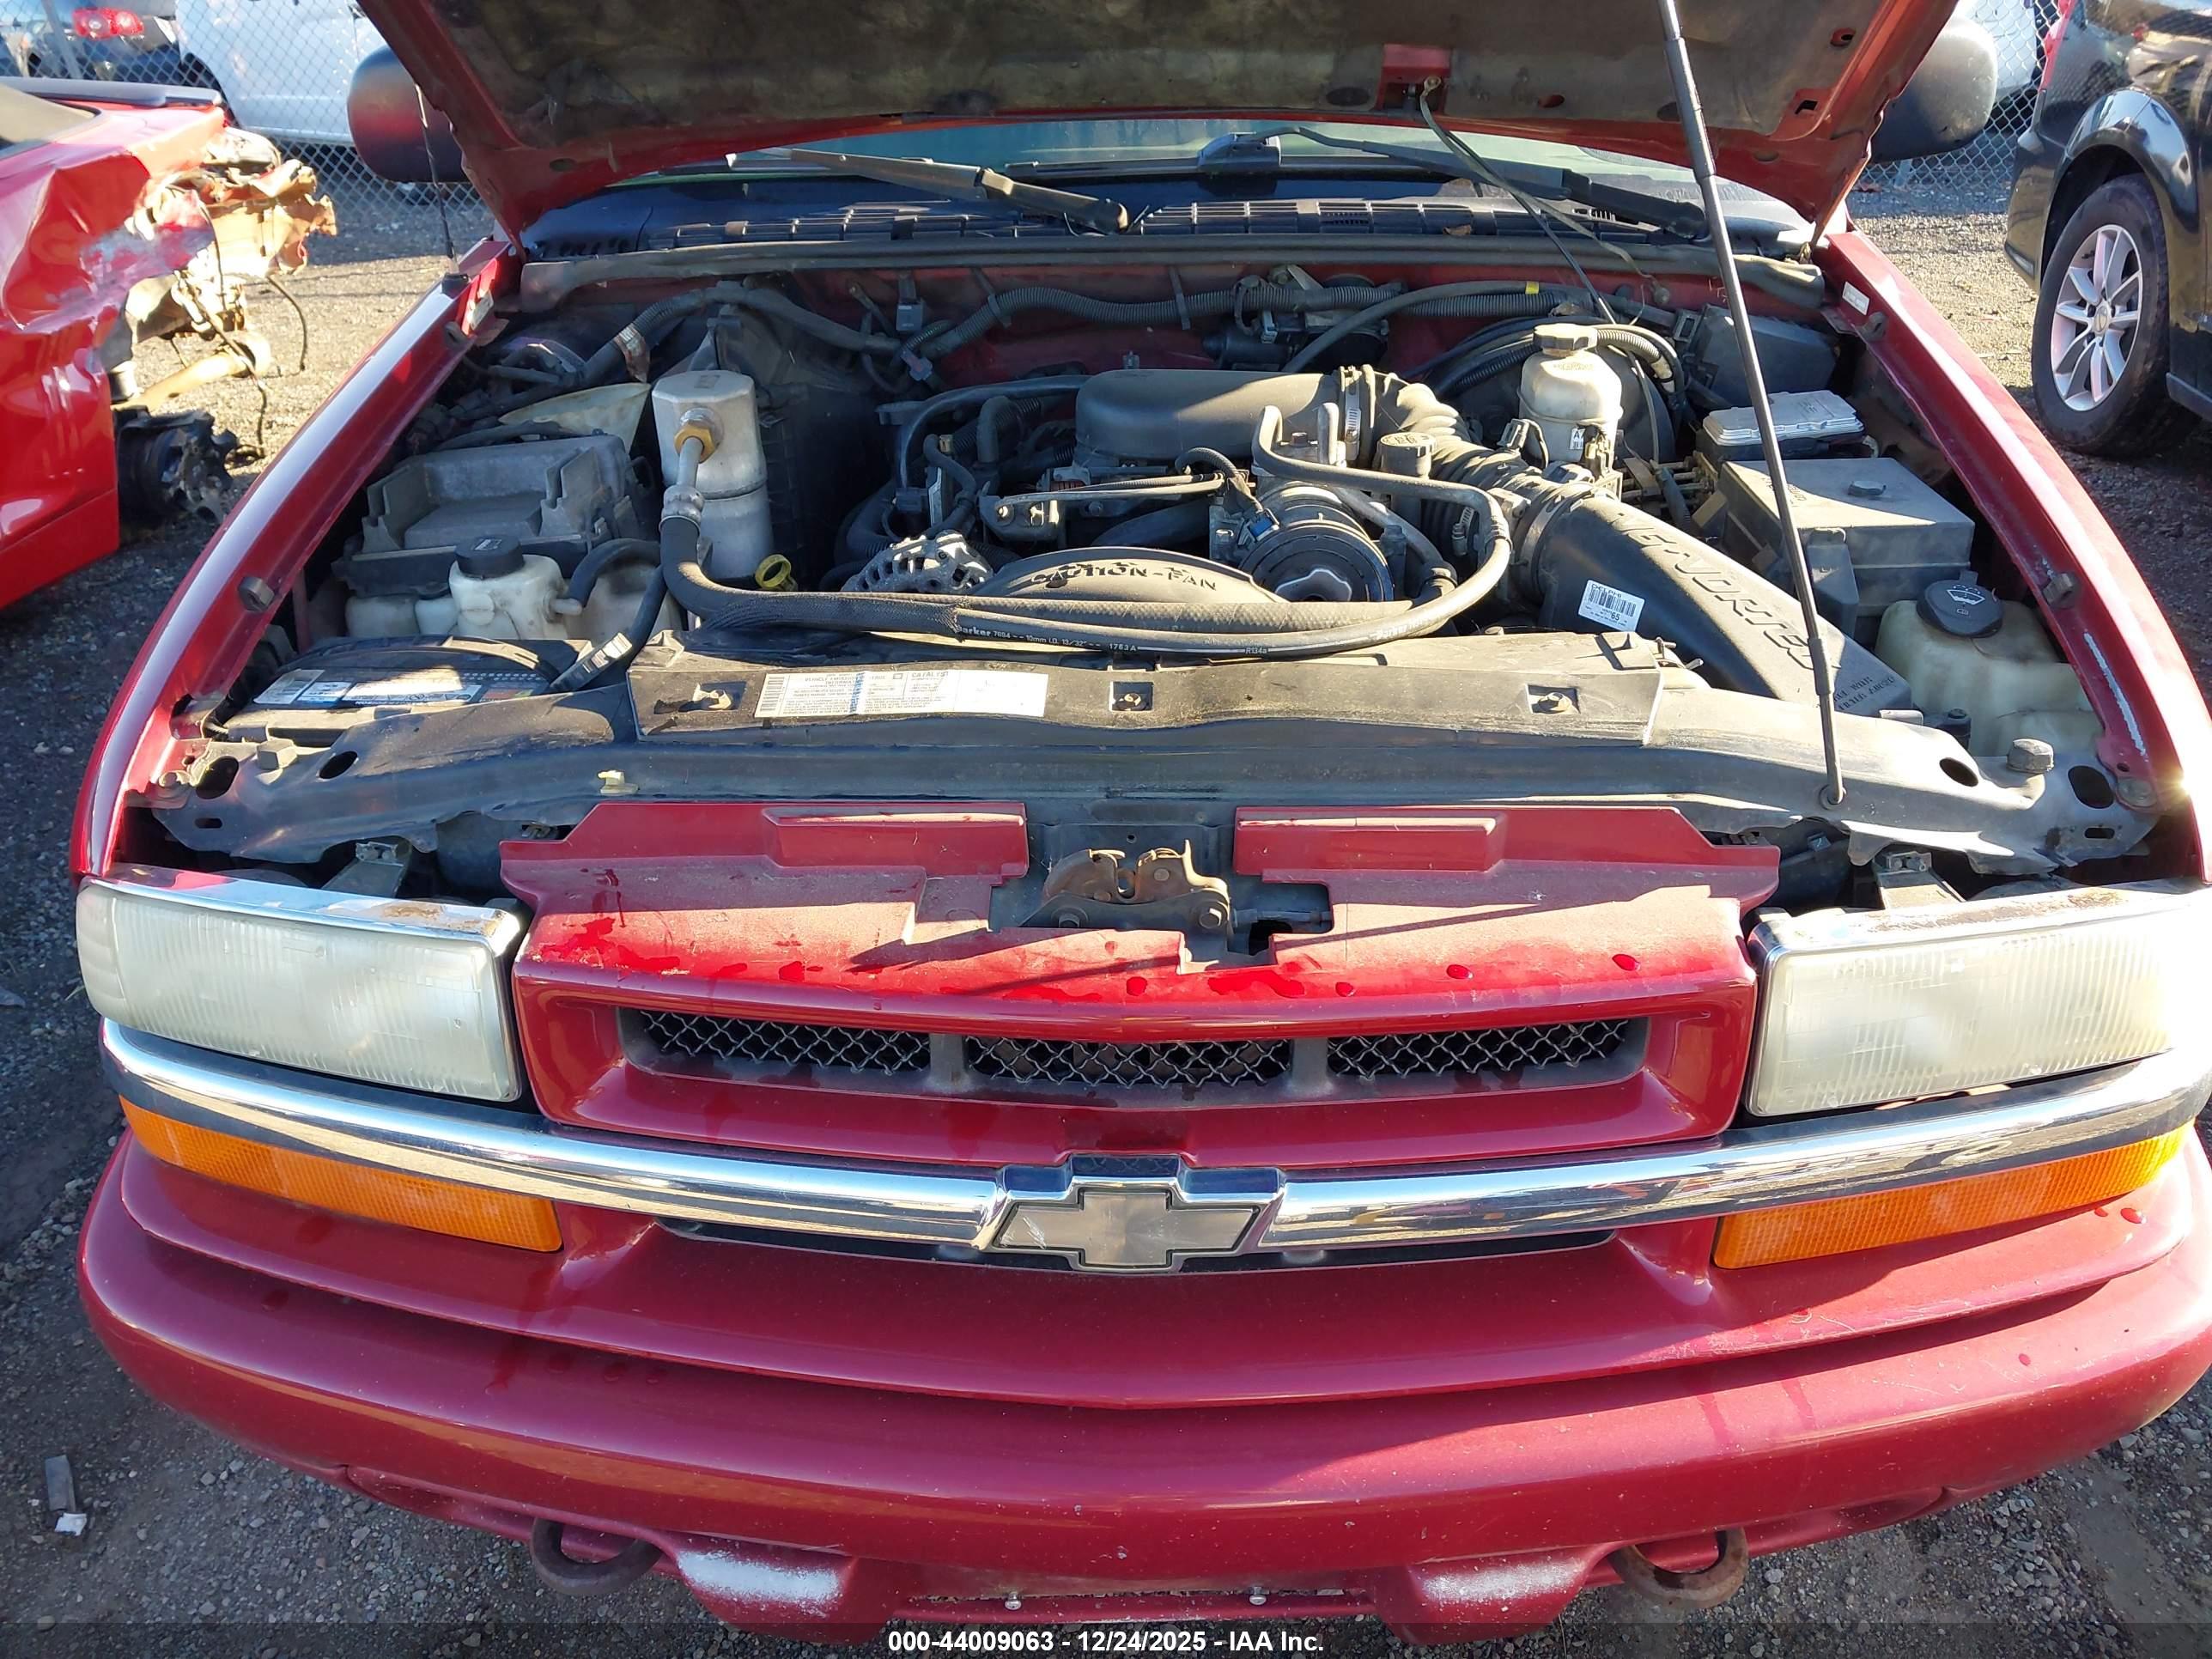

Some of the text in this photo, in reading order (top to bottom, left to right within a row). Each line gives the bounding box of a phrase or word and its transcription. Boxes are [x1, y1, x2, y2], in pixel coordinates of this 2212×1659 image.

[1030, 562, 1148, 585] CAUTION
[1164, 567, 1218, 591] FAN
[1245, 647, 1267, 655] R134a
